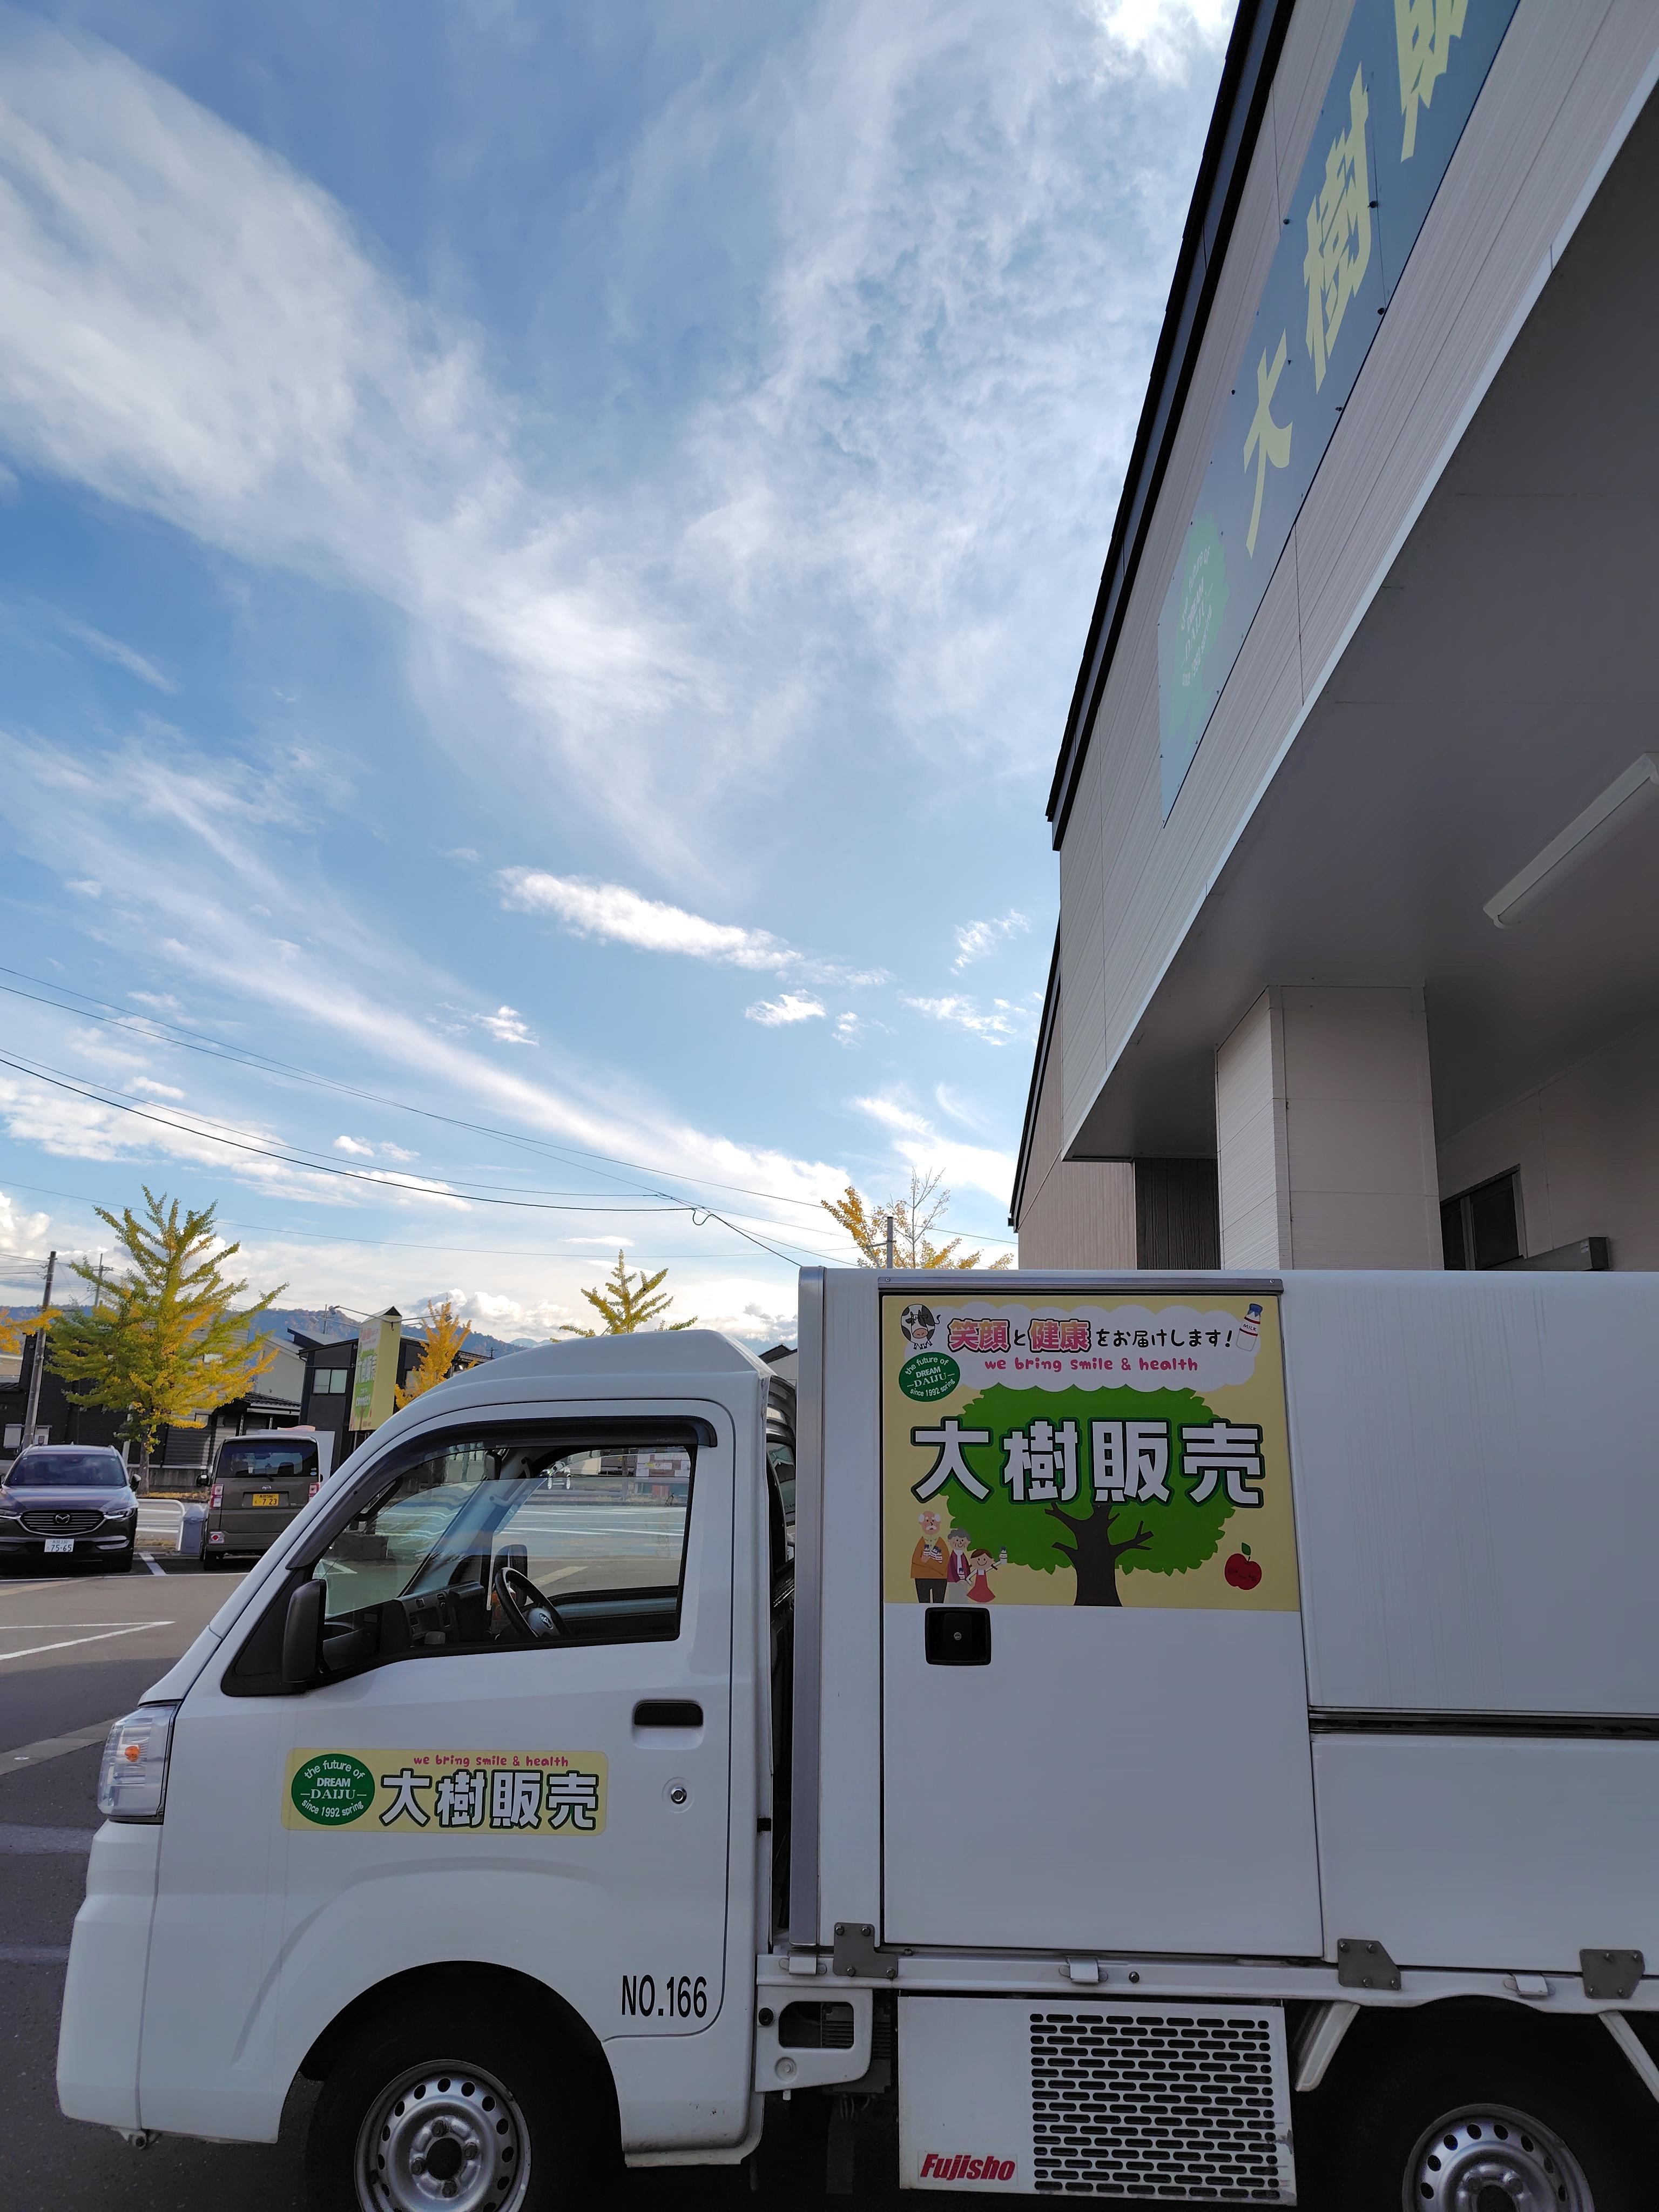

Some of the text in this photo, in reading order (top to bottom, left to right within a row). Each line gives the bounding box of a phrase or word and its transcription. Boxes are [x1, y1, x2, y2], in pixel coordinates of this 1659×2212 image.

[1189, 551, 1204, 592] future
[1188, 576, 1204, 632] DREAM
[1243, 1324, 1257, 1332] MILK
[905, 1364, 916, 1375] the
[916, 1357, 938, 1366] future
[915, 1366, 941, 1378] DREAM
[984, 1357, 1198, 1373] we bring smile & health
[910, 1378, 955, 1397] since 1992 spring
[912, 1418, 1264, 1507] 大樹販売
[304, 1759, 366, 1779] the future of
[414, 1755, 569, 1767] we bring smile & health
[316, 1777, 351, 1787] DREAM
[301, 1799, 364, 1818] since 1992 spring
[379, 1768, 599, 1830] 大樹販売
[622, 1974, 707, 2018] NO.166
[920, 2154, 1016, 2181] Fujisho
